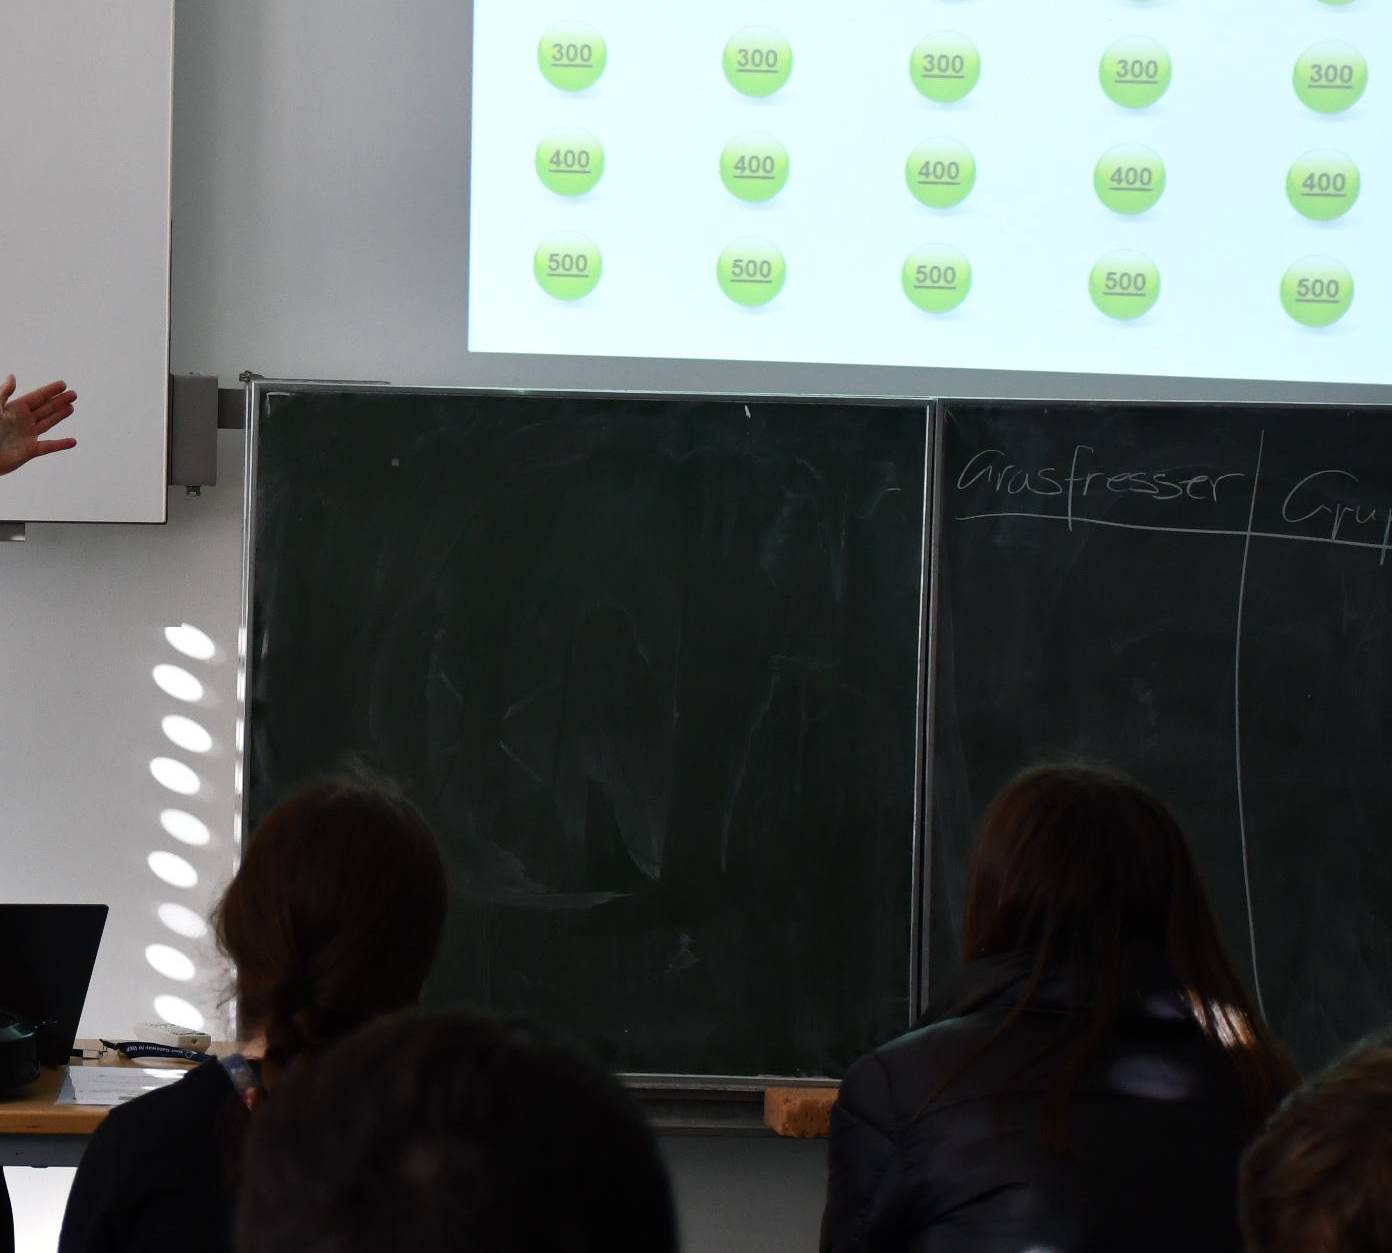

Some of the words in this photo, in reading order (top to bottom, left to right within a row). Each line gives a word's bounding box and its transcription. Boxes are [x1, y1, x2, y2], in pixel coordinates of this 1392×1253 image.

[552, 43, 593, 63] 300
[736, 48, 778, 68] 300
[922, 53, 965, 73] 300
[1115, 59, 1159, 79] 300
[1309, 63, 1353, 84] 300
[548, 149, 590, 169] 400
[733, 154, 775, 174] 400
[917, 160, 960, 181] 400
[1109, 166, 1153, 186] 400
[1301, 172, 1346, 192] 400
[547, 253, 588, 273] 500
[730, 258, 772, 278] 500
[914, 264, 957, 285] 500
[1104, 271, 1147, 292] 500
[1296, 278, 1339, 299] 500
[956, 444, 1246, 532] Grasfresser
[1281, 469, 1392, 567] Gru
